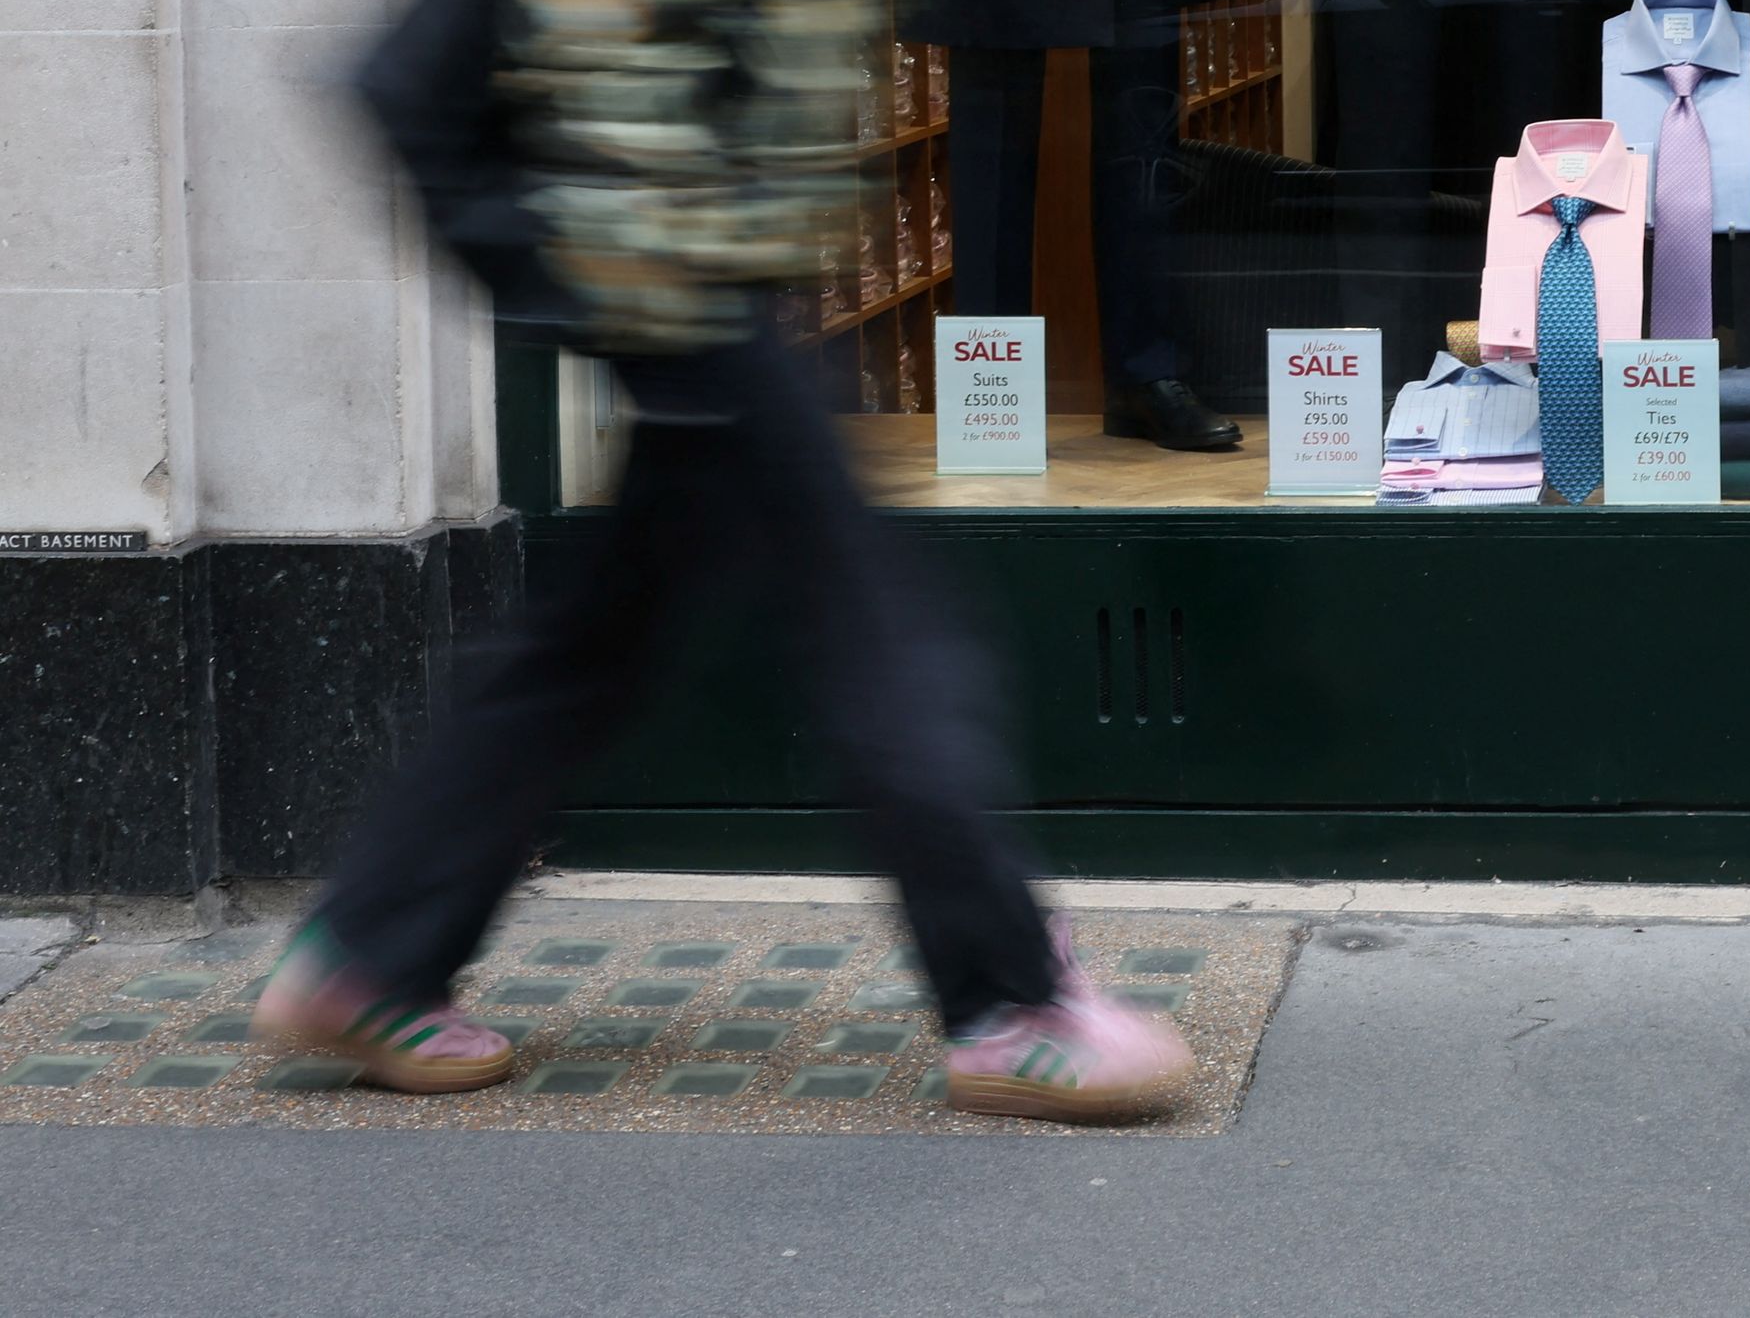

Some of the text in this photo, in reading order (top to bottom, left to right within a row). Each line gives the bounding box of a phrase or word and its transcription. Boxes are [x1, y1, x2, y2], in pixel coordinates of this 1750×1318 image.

[967, 327, 1010, 342] Winter
[955, 342, 1022, 362] SALE
[1302, 339, 1346, 355] Winter
[1638, 350, 1682, 366] Winter
[1288, 355, 1359, 376] SALE
[973, 373, 1008, 387] Suits
[1623, 366, 1695, 387] SALE
[965, 394, 1018, 406] £550.00
[1304, 391, 1348, 406] Shirts
[965, 413, 1018, 426] £495.00
[1305, 413, 1348, 425] £95.00
[1647, 411, 1676, 424] Ties
[983, 432, 1020, 441] £900.00
[1302, 432, 1350, 445] £59.00
[1635, 432, 1689, 444] £69/£79
[1316, 451, 1357, 461] £150.00
[1638, 451, 1686, 464] £39.00
[1654, 471, 1690, 481] £60.00
[41, 534, 133, 548] BASEMENT
